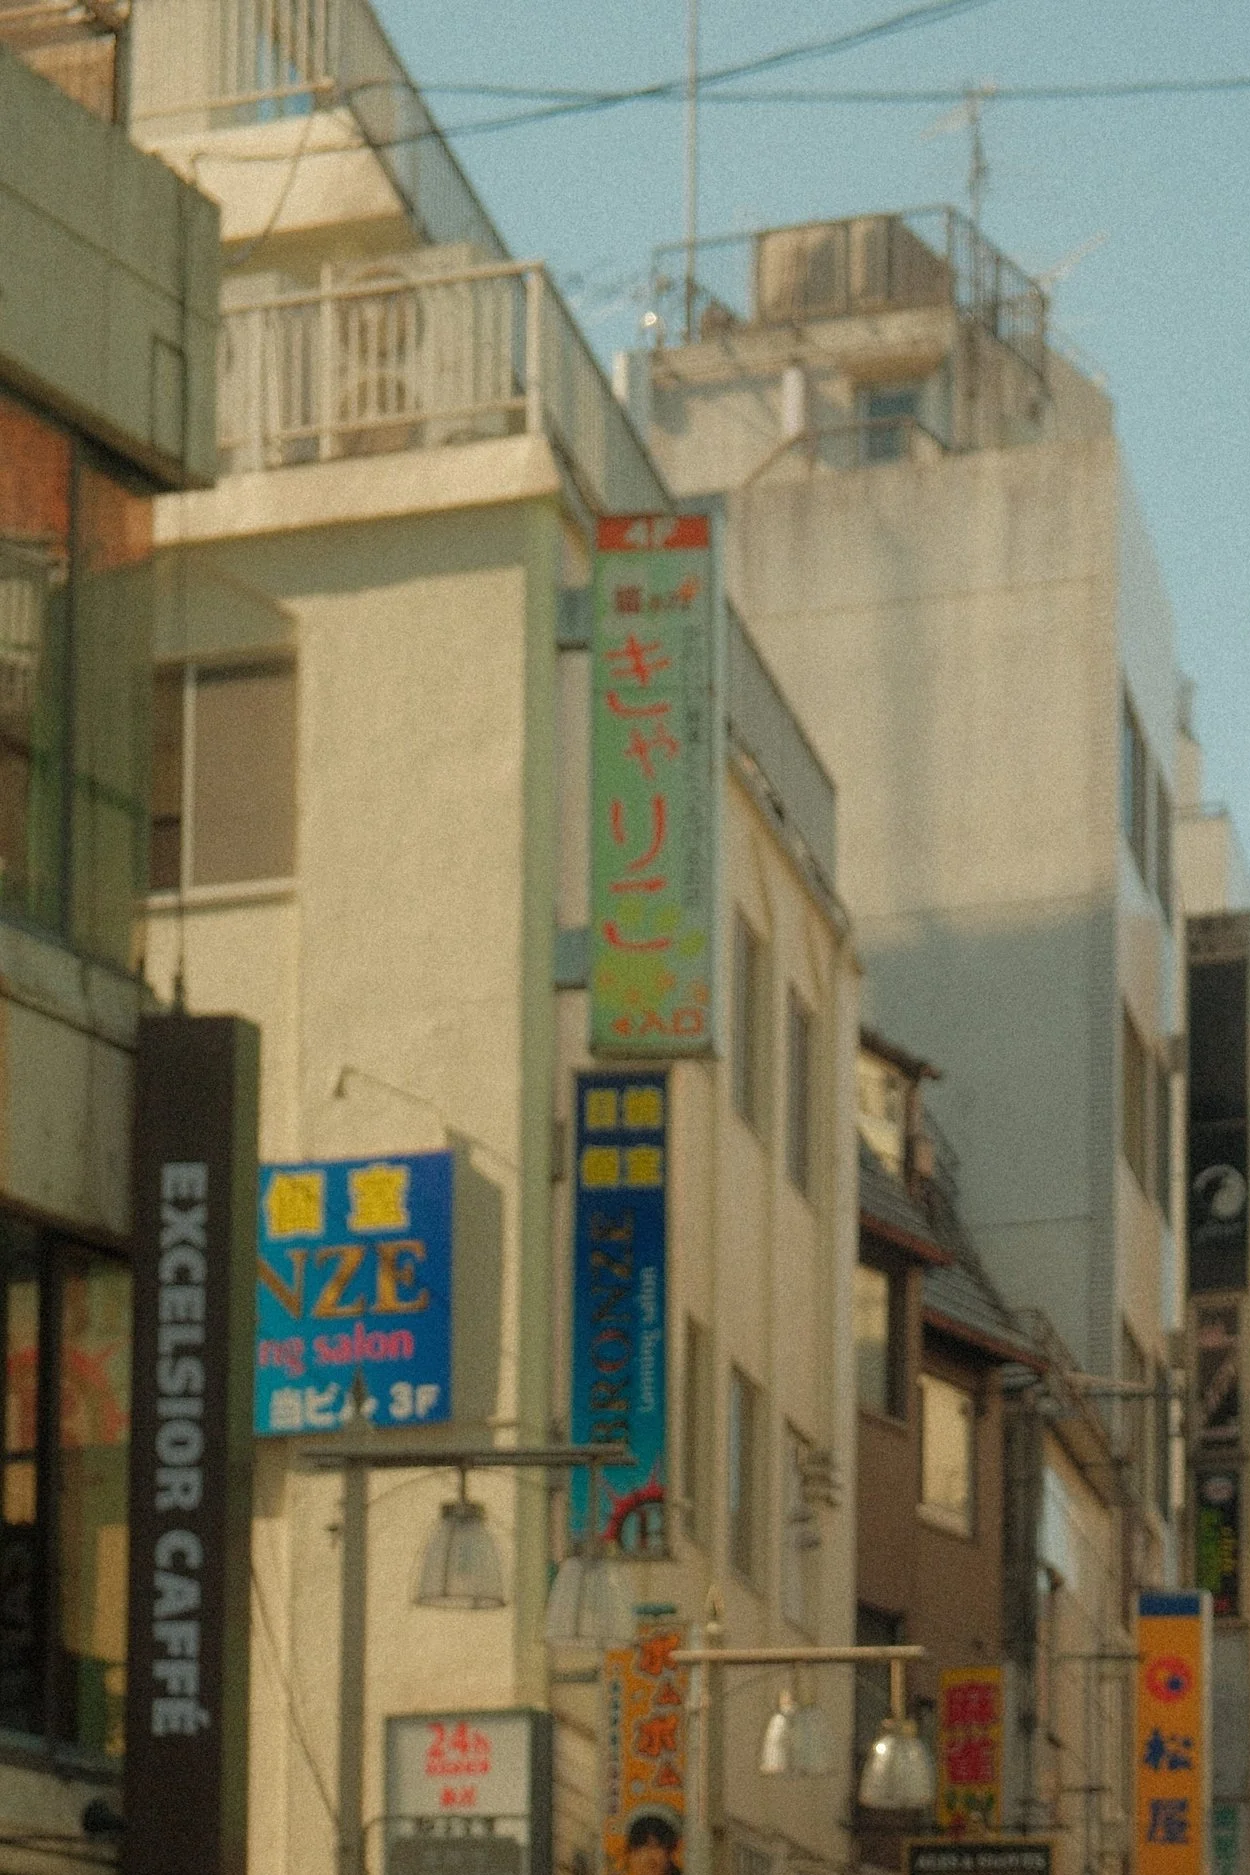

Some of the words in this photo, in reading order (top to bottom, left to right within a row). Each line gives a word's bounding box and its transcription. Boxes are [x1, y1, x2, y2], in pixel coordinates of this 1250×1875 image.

[152, 1160, 208, 1510] EXCELSIOR
[313, 1322, 416, 1365] salon
[589, 1209, 635, 1448] BRONZE
[150, 1530, 206, 1737] CAFFÉ
[1143, 1727, 1195, 1846] 松屋
